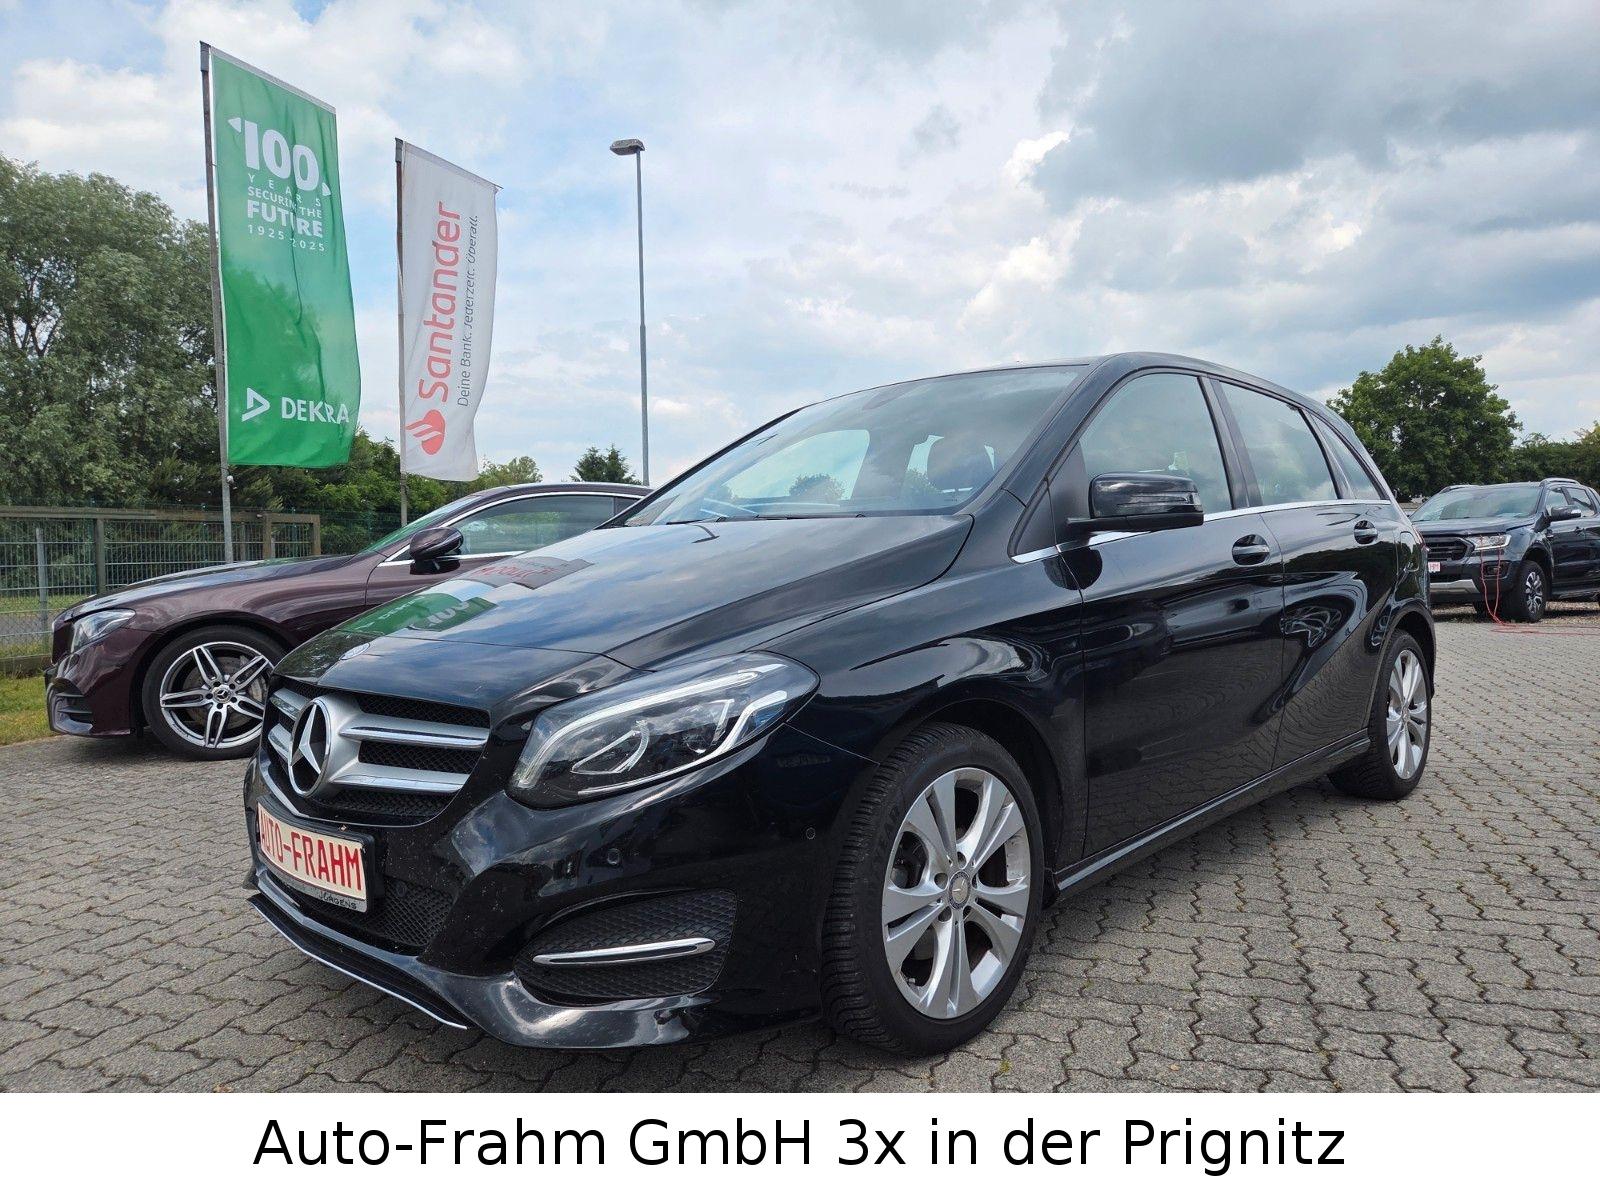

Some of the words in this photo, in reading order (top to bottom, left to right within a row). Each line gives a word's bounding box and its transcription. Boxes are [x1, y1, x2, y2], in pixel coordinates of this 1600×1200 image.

[245, 119, 320, 191] 100
[247, 186, 298, 212] SECURIN
[299, 206, 322, 219] THE
[465, 215, 478, 264] Überall.
[418, 201, 461, 403] Santander
[460, 333, 472, 367] Bank.
[457, 370, 471, 407] Deine
[281, 396, 350, 425] DEKRA
[259, 809, 363, 892] AUTO-FRAHM
